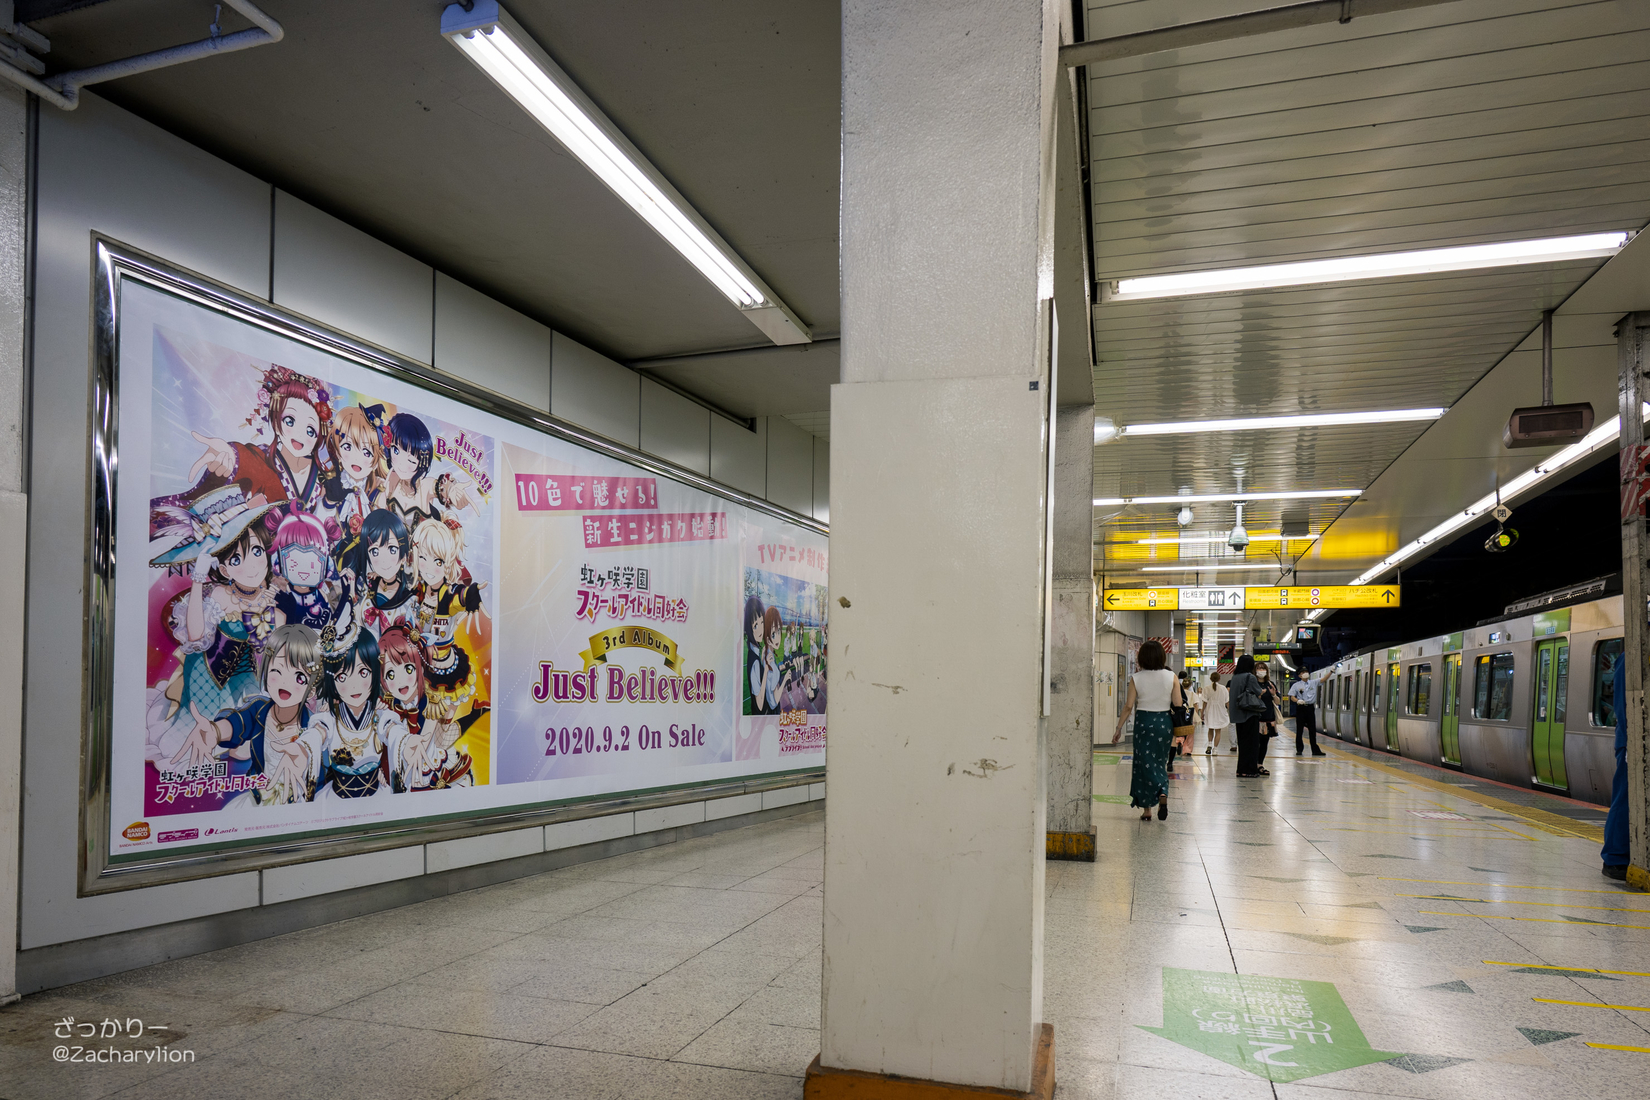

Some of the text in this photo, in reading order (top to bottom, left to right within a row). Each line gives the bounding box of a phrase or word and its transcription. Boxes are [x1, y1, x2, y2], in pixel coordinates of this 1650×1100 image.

[454, 430, 484, 464] Just
[435, 436, 494, 495] Believe!!!
[517, 478, 655, 507] 10色で魅せる!
[584, 515, 726, 545] 新生ニジガク始動!
[757, 543, 829, 574] TVアニメ制作
[576, 589, 687, 621] スクールアイドル同好会
[602, 630, 670, 656] 3rd Album
[533, 662, 716, 702] Just Believe!!!
[545, 723, 706, 756] 2020.9.2 On Sale
[155, 773, 268, 804] スクールアイドル同好会
[126, 826, 148, 834] BANDAI
[214, 827, 238, 835] Lantis
[1192, 1008, 1332, 1032] (内回り)
[1197, 1019, 1334, 1044] 山手線
[1248, 1040, 1299, 1067] 2
